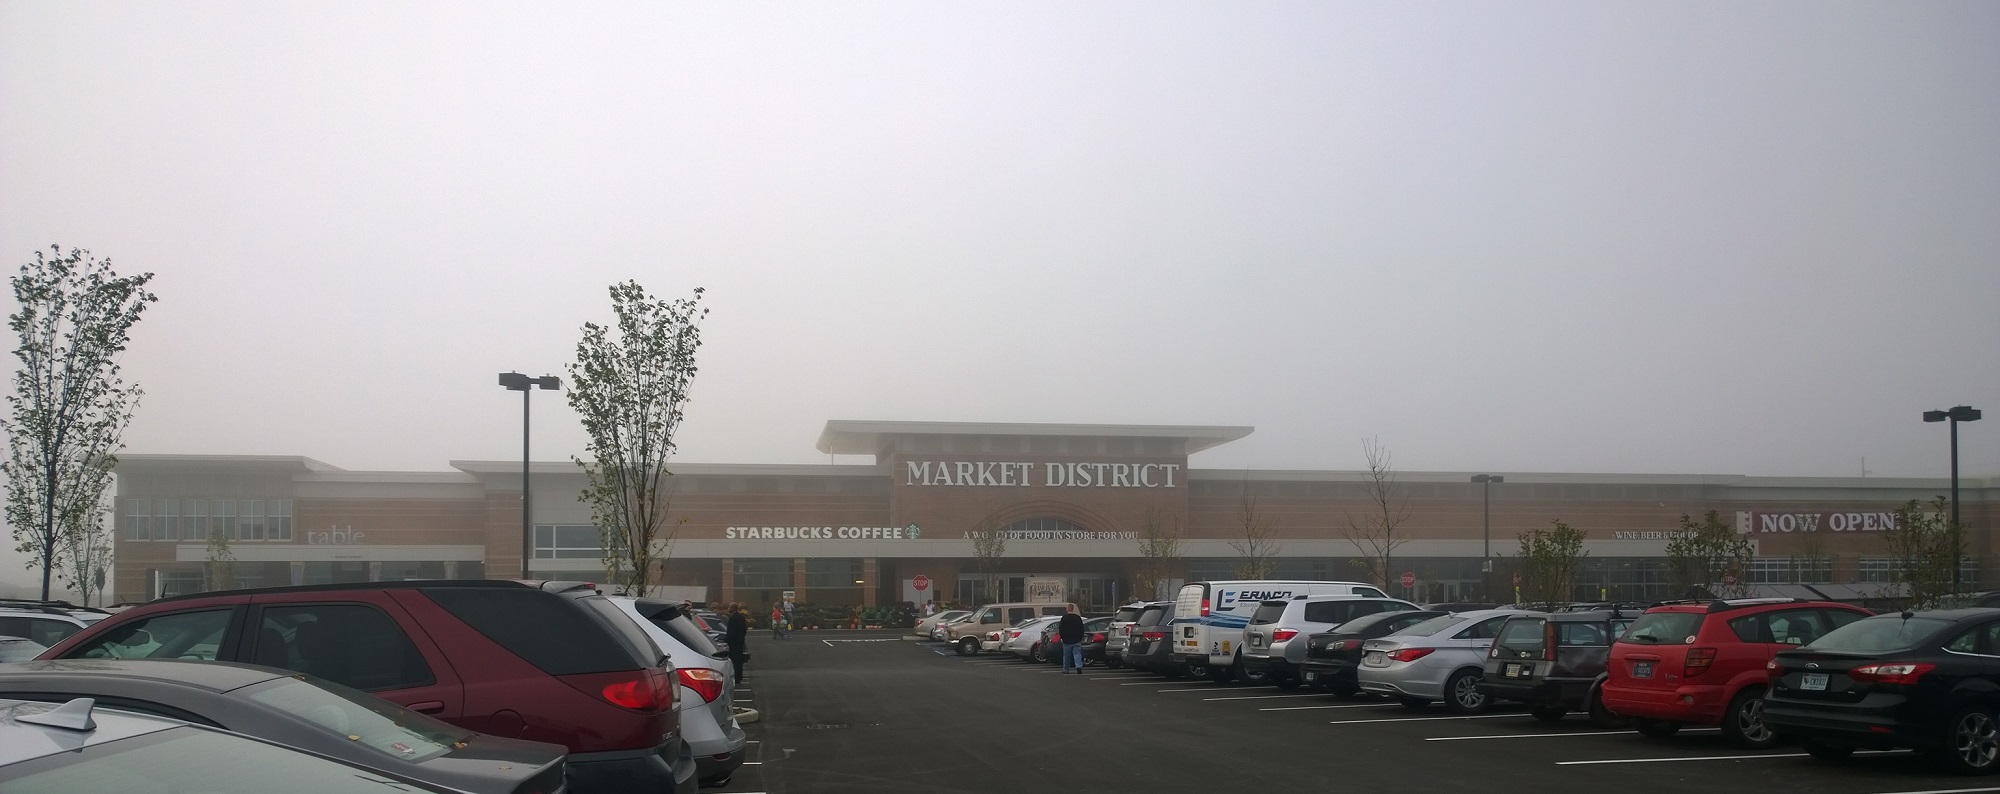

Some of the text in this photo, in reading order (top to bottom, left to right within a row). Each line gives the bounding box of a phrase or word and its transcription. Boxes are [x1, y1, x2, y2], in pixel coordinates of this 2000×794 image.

[906, 461, 1180, 488] MARKET DISTRICT
[1760, 513, 1822, 533] NOW
[307, 524, 365, 545] table
[726, 526, 902, 539] STARBUCKS COFFEE
[962, 531, 970, 540] A
[1010, 531, 1023, 540] OF
[1025, 531, 1051, 540] FOOD
[1053, 531, 1063, 540] IN
[1065, 531, 1096, 540] STORE
[1099, 531, 1121, 540] FOR
[1120, 531, 1138, 540] YOU
[1640, 531, 1662, 540] BEER
[913, 579, 928, 587] STOP
